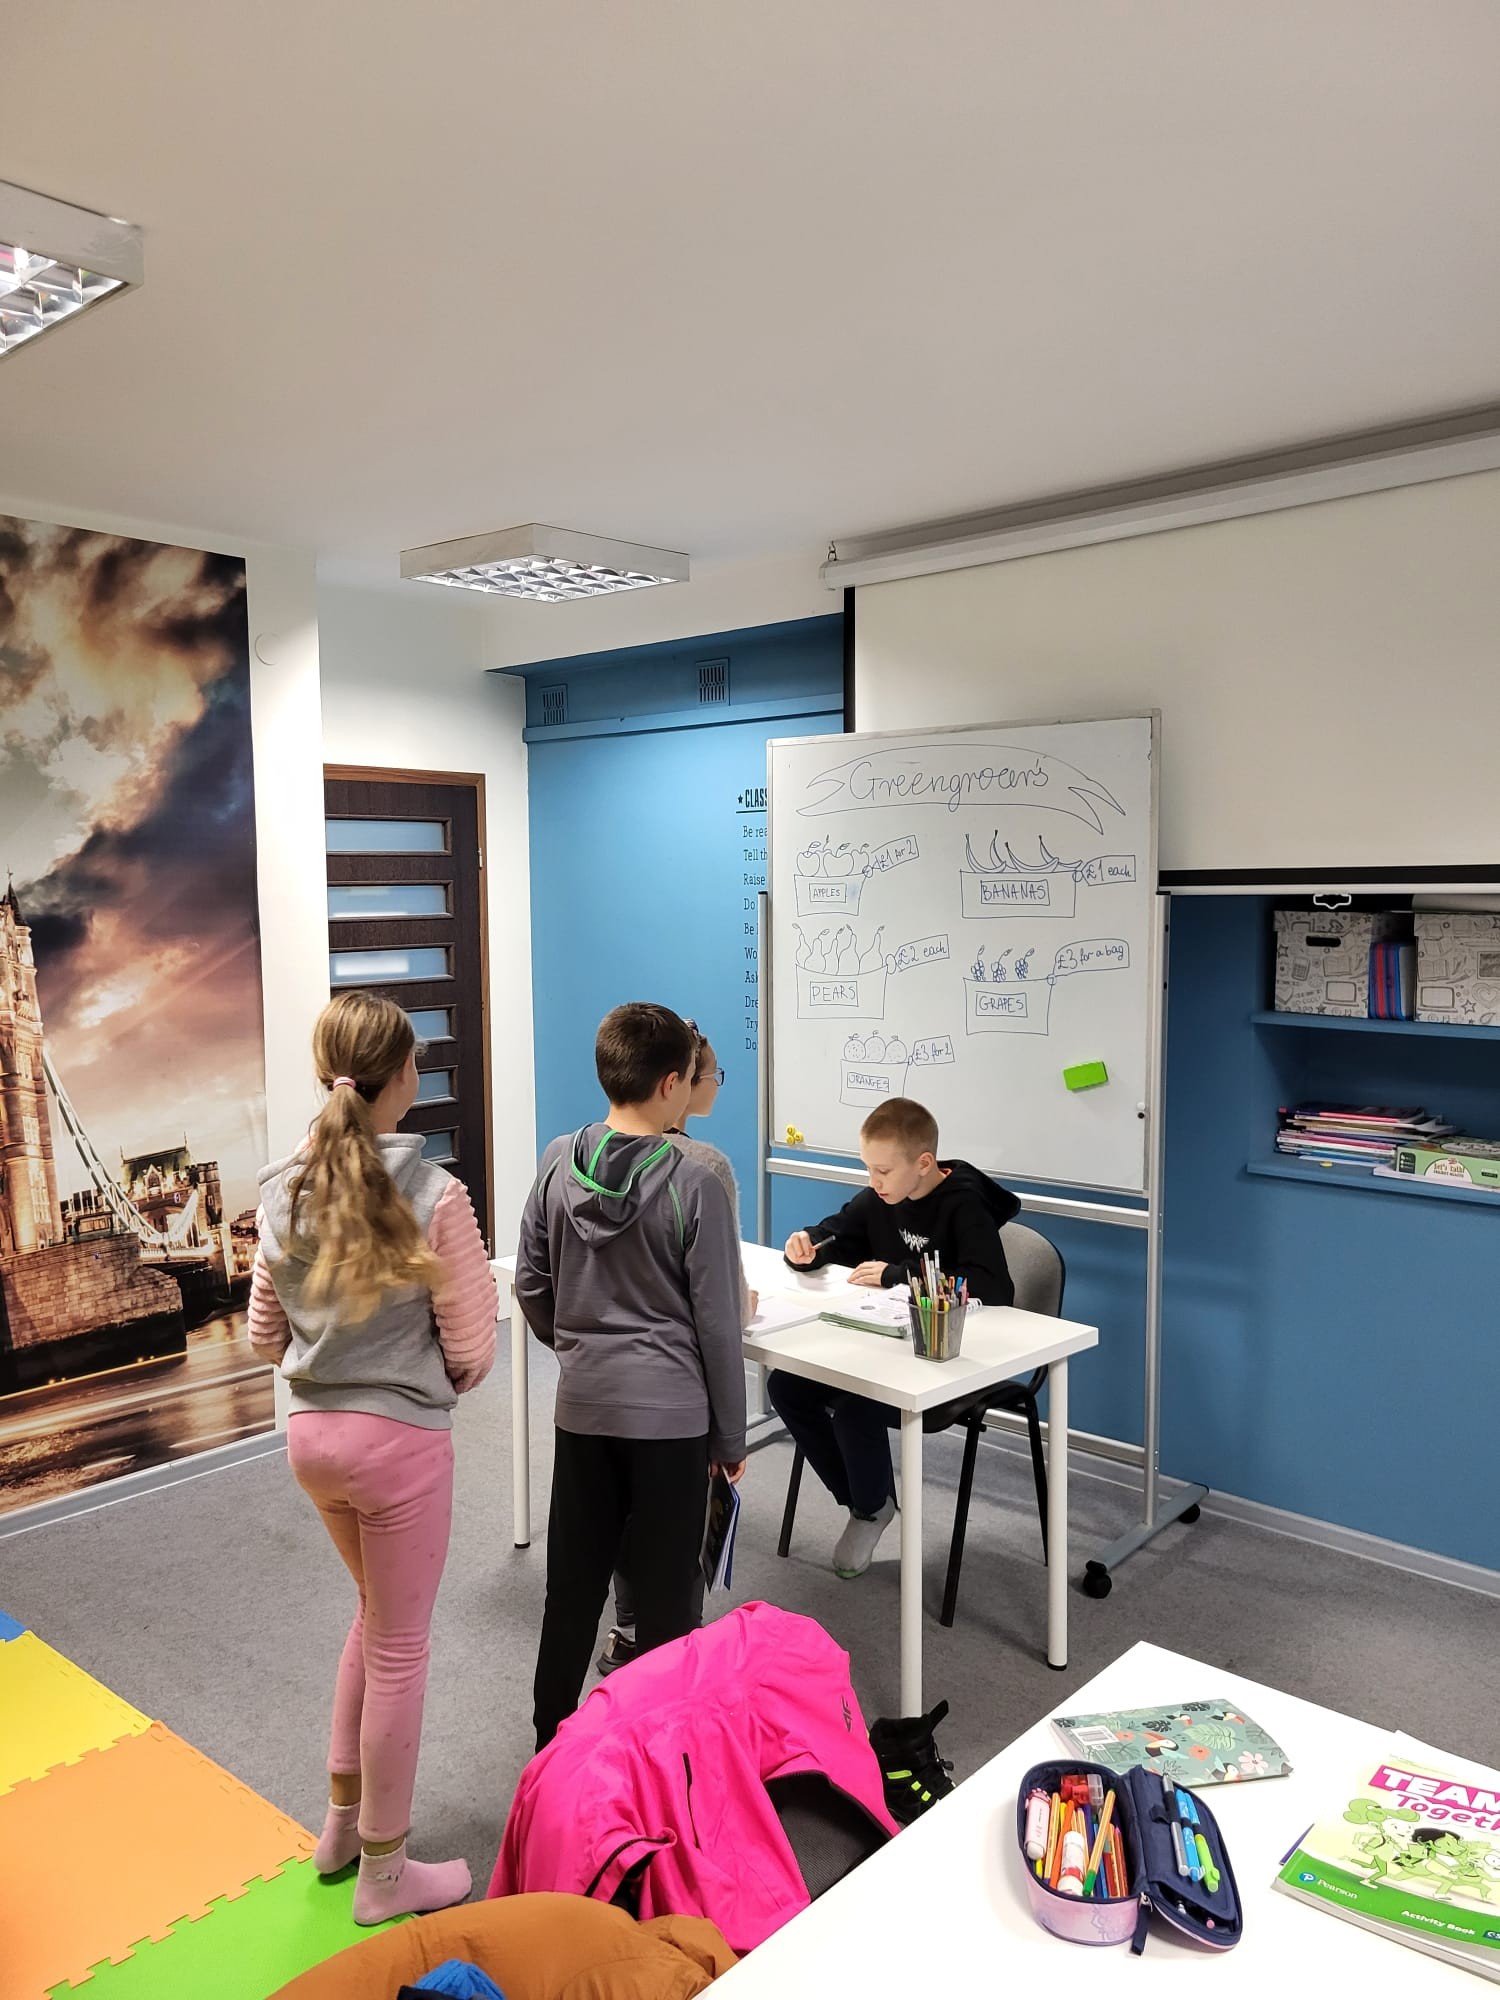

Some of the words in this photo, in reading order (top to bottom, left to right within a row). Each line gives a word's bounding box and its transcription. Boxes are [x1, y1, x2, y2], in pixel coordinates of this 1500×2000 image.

[743, 825, 753, 838] Be
[743, 848, 758, 861] Tell
[906, 839, 916, 855] 2
[1086, 859, 1104, 881] £1
[1108, 865, 1132, 878] each
[743, 873, 766, 886] Raise
[813, 887, 841, 898] APPLES
[983, 884, 1047, 901] BANANAS
[744, 922, 755, 936] Be
[897, 945, 920, 966] £2
[923, 941, 947, 958] each
[1057, 948, 1078, 970] £3
[1080, 947, 1095, 966] for
[1096, 950, 1102, 958] a
[1104, 944, 1124, 961] bag
[812, 984, 857, 1002] PEARS
[979, 995, 1024, 1013] GRAPES
[915, 1043, 930, 1062] £3
[931, 1042, 944, 1063] for
[944, 1042, 952, 1056] 2
[848, 1074, 889, 1090] ORANGES
[1317, 1878, 1358, 1900] Pearson
[1401, 1910, 1446, 1928] Activity
[1446, 1923, 1476, 1936] Book
